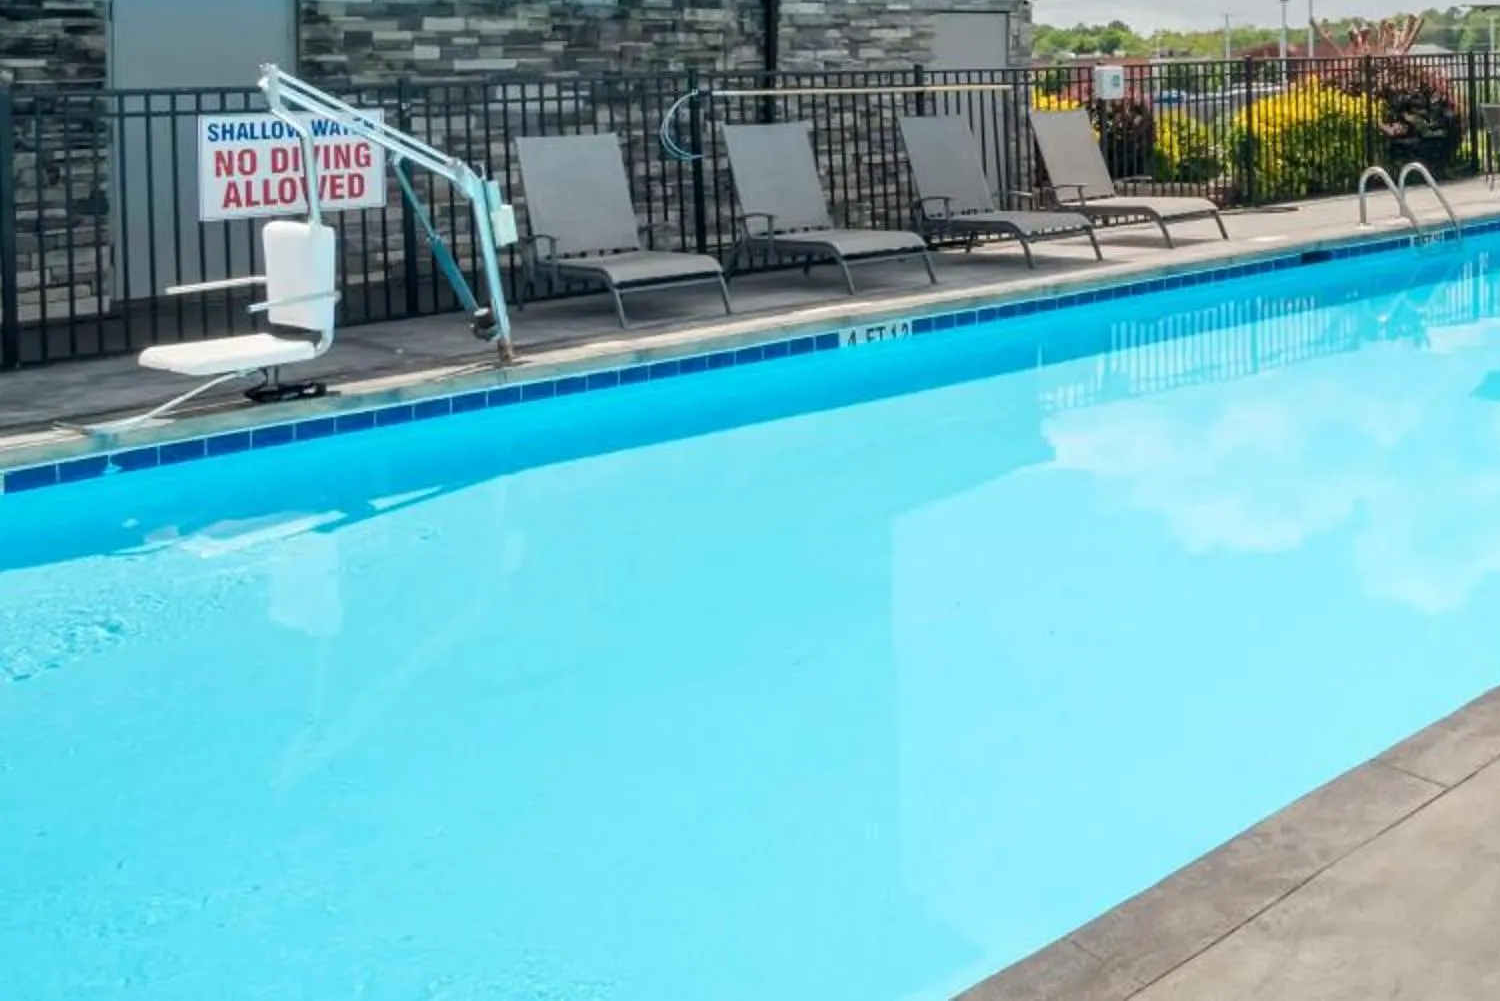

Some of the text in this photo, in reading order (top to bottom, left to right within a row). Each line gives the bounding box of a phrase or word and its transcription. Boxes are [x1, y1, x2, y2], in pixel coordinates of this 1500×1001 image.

[214, 148, 258, 177] NO
[222, 172, 365, 209] ALLOWED
[865, 326, 887, 344] FT
